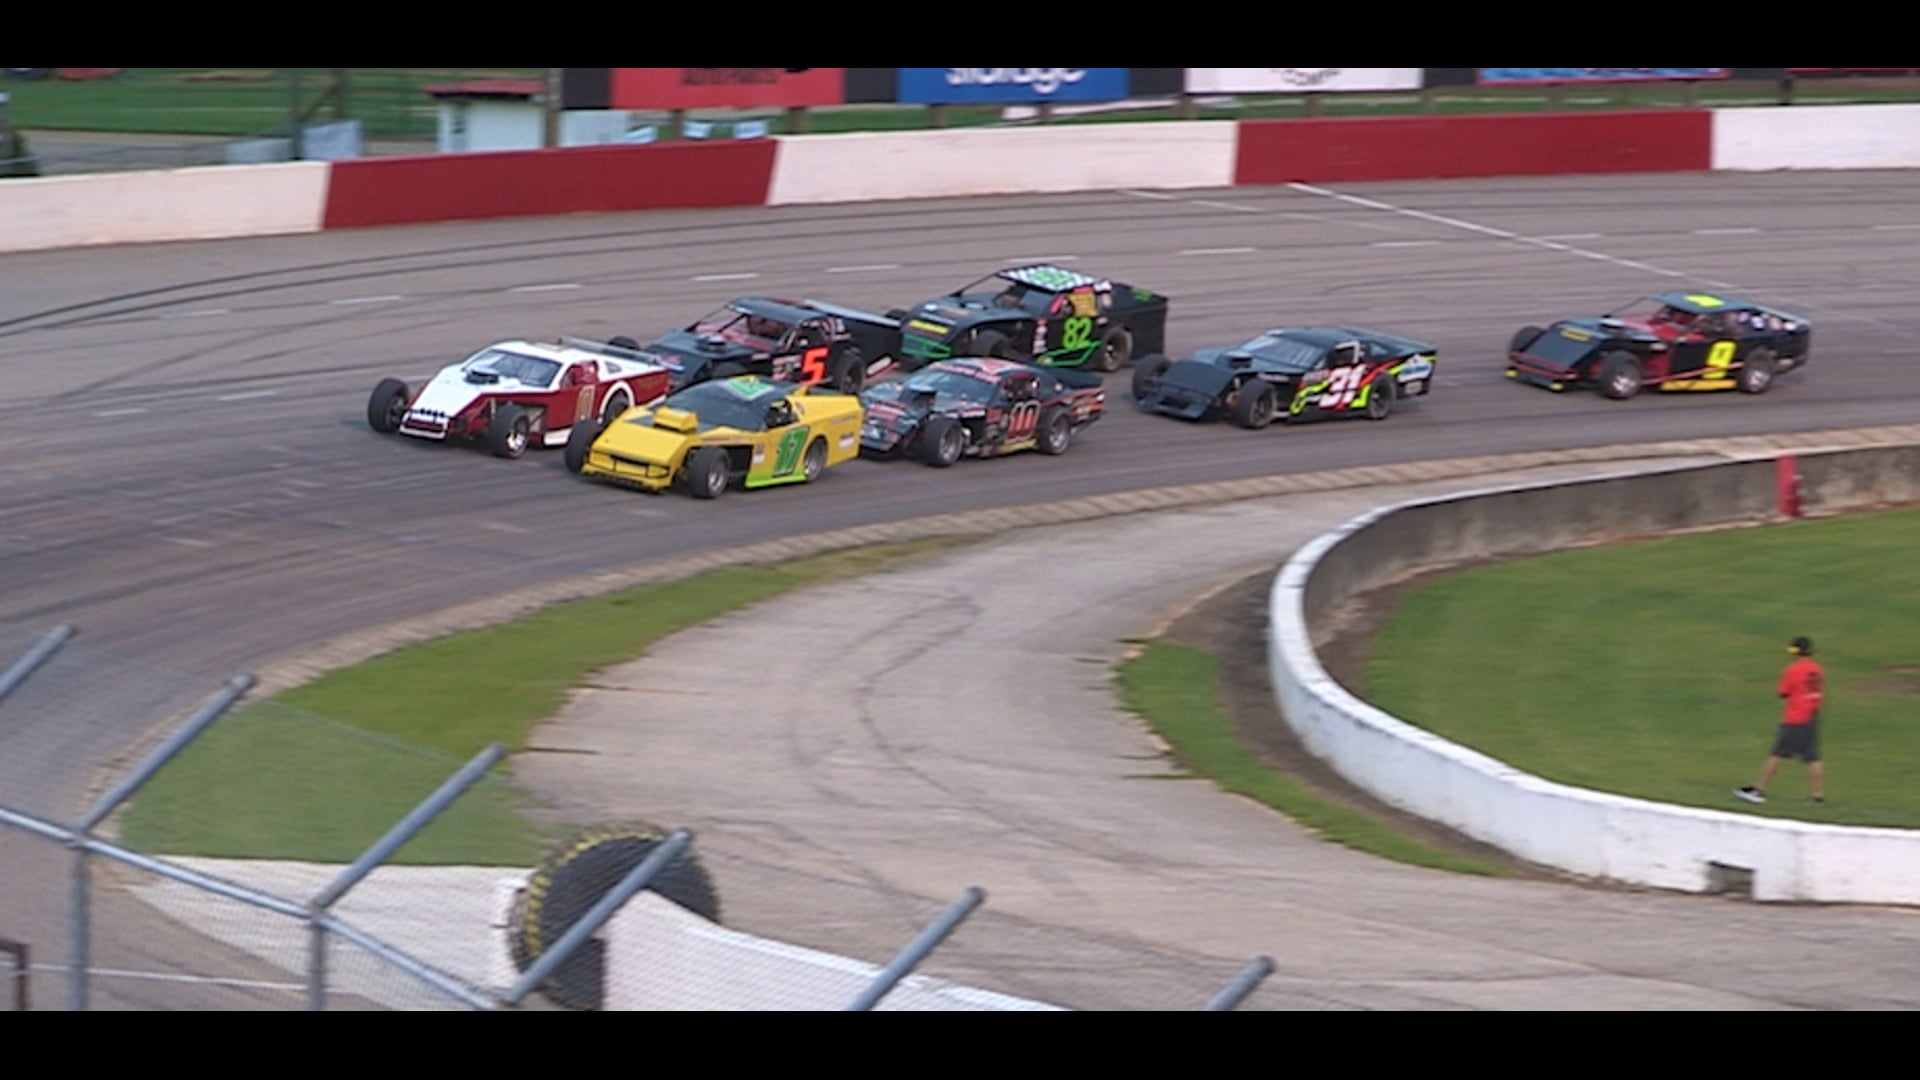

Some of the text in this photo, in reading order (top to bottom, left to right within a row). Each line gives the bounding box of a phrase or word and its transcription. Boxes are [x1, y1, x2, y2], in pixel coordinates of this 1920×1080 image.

[1063, 317, 1093, 350] 82
[799, 347, 830, 386] 5
[1702, 340, 1737, 379] 9
[1004, 400, 1041, 443] 10
[772, 426, 810, 477] 17
